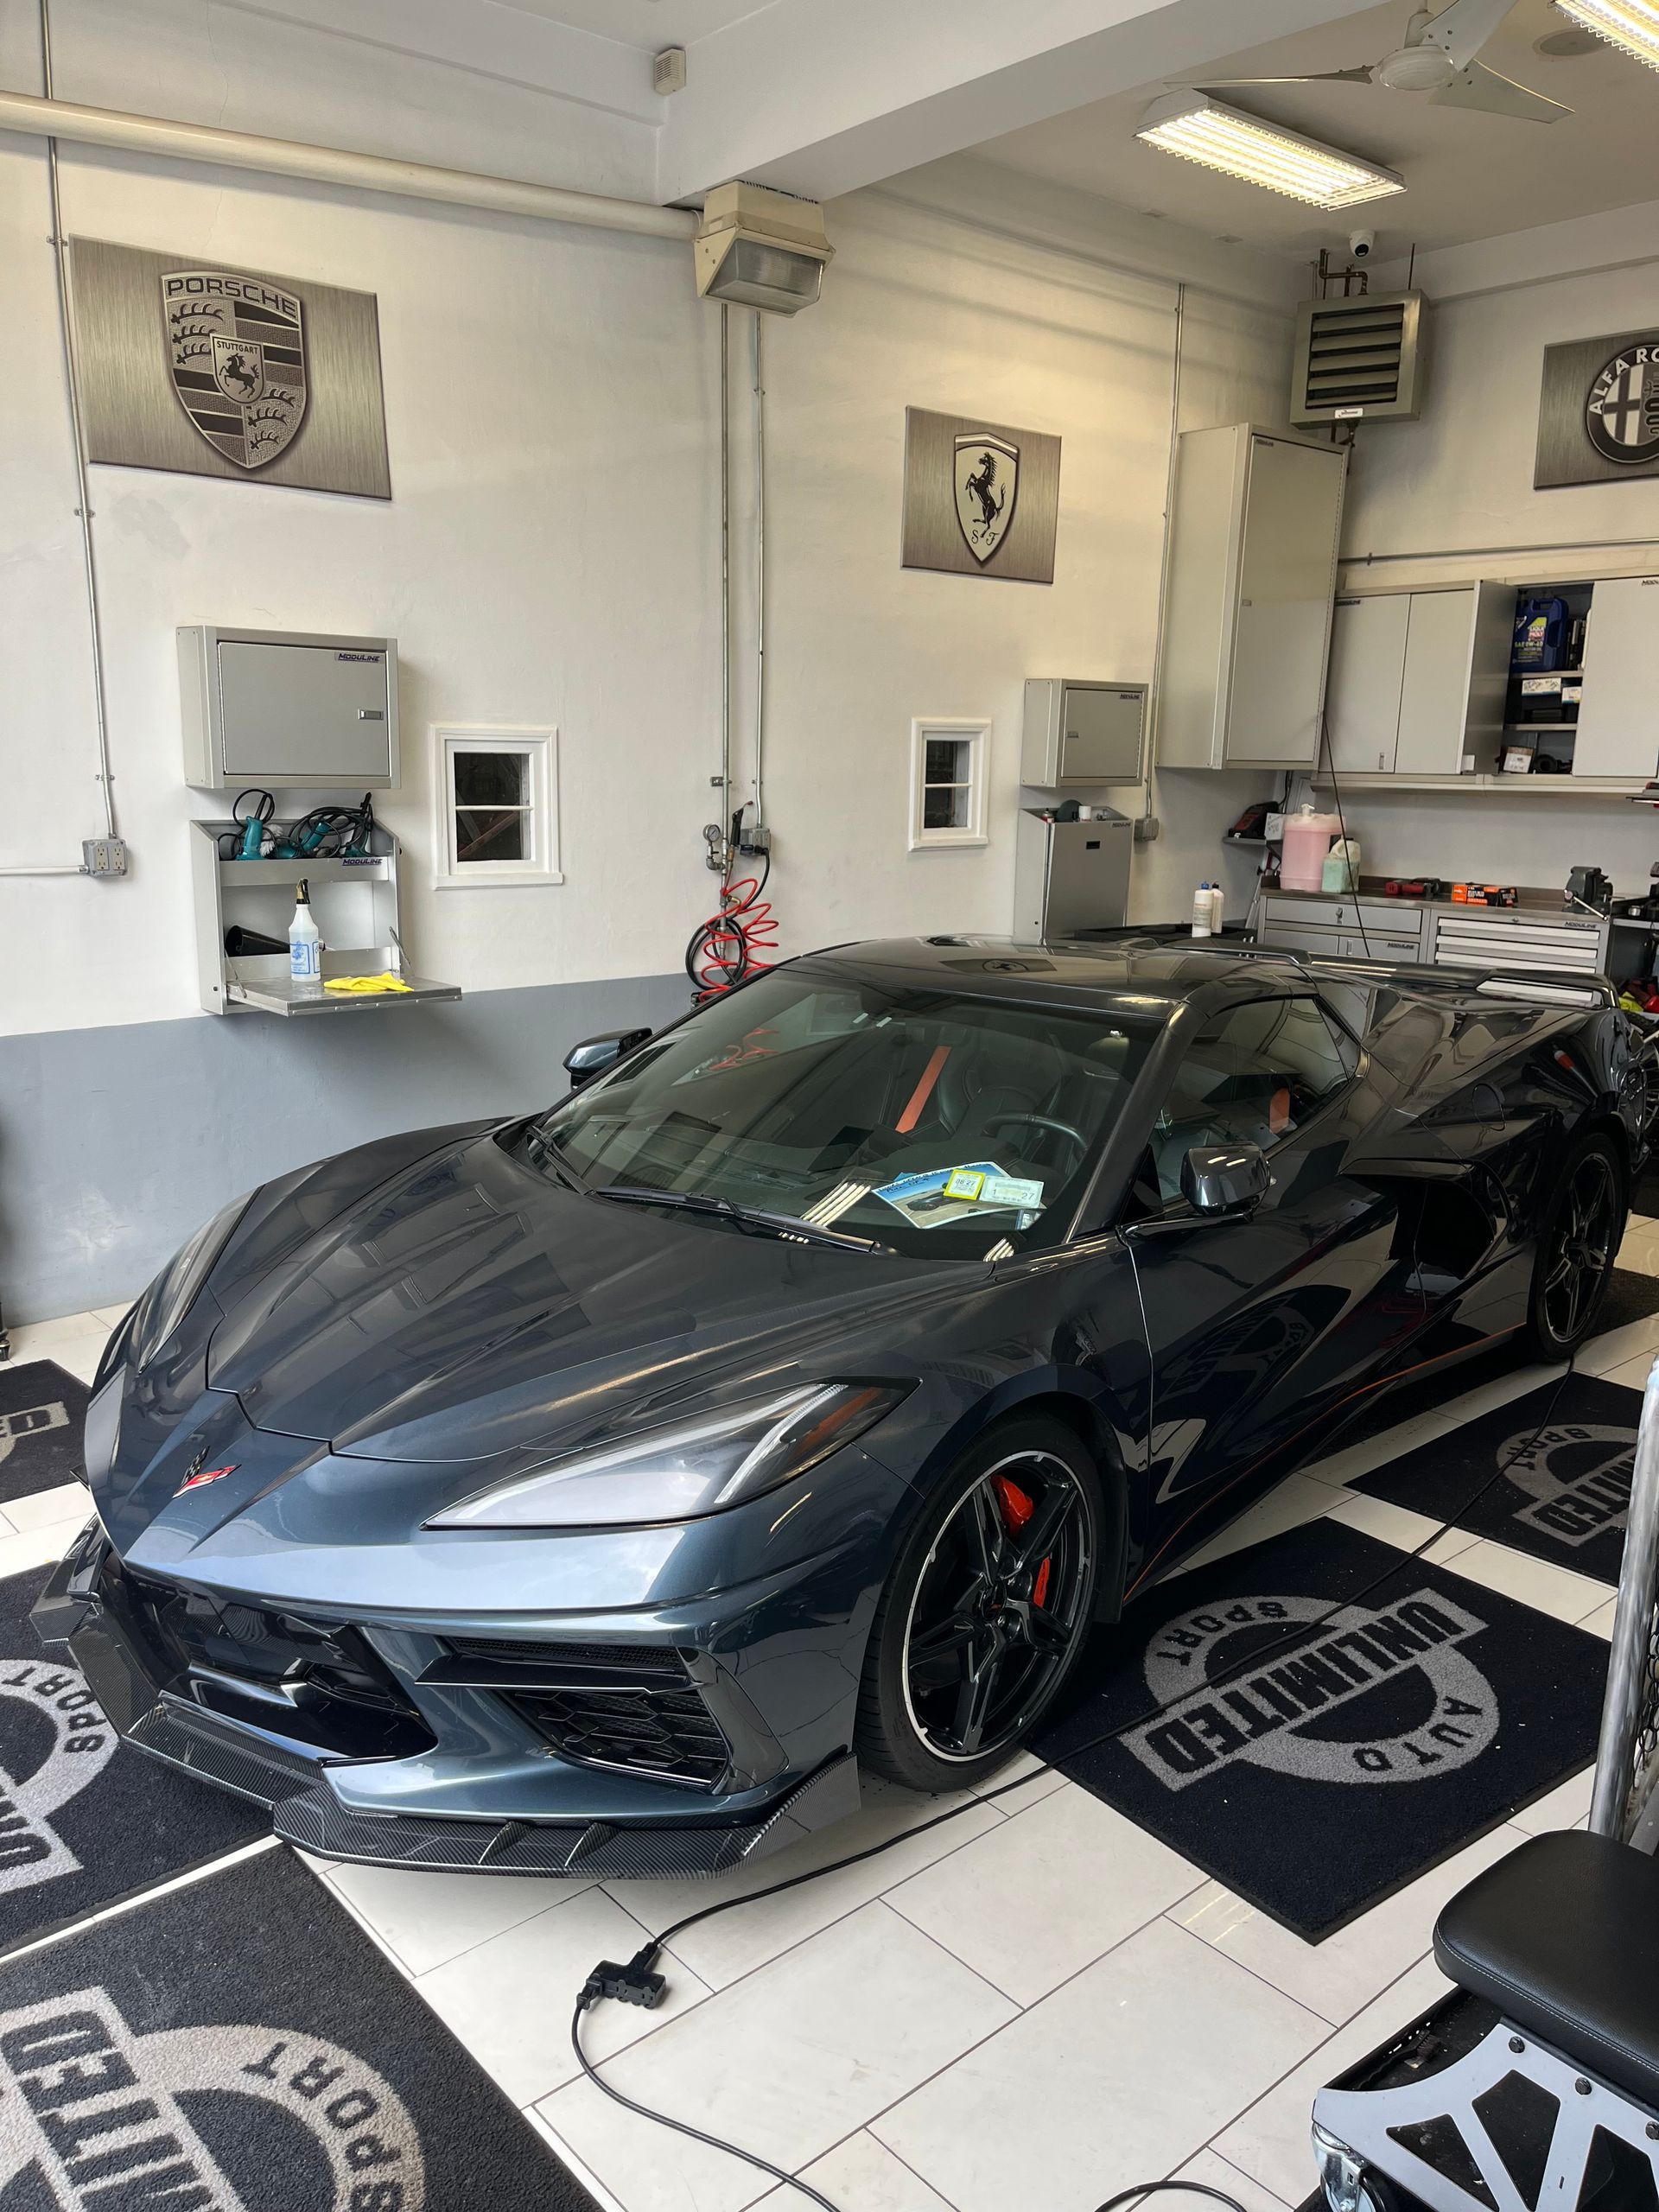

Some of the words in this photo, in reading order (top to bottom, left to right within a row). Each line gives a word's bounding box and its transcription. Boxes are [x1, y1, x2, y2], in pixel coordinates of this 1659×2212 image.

[168, 277, 296, 319] PORSCHE
[216, 340, 258, 355] STUTTGART
[1589, 358, 1630, 415] ALFA
[971, 530, 980, 544] S
[1021, 1192, 1035, 1200] 27
[1156, 1601, 1287, 1667] SPORT
[2, 1666, 107, 1753] SPORT
[1144, 1601, 1465, 1774] UNLIMITED
[1352, 1696, 1484, 1772] AUTO
